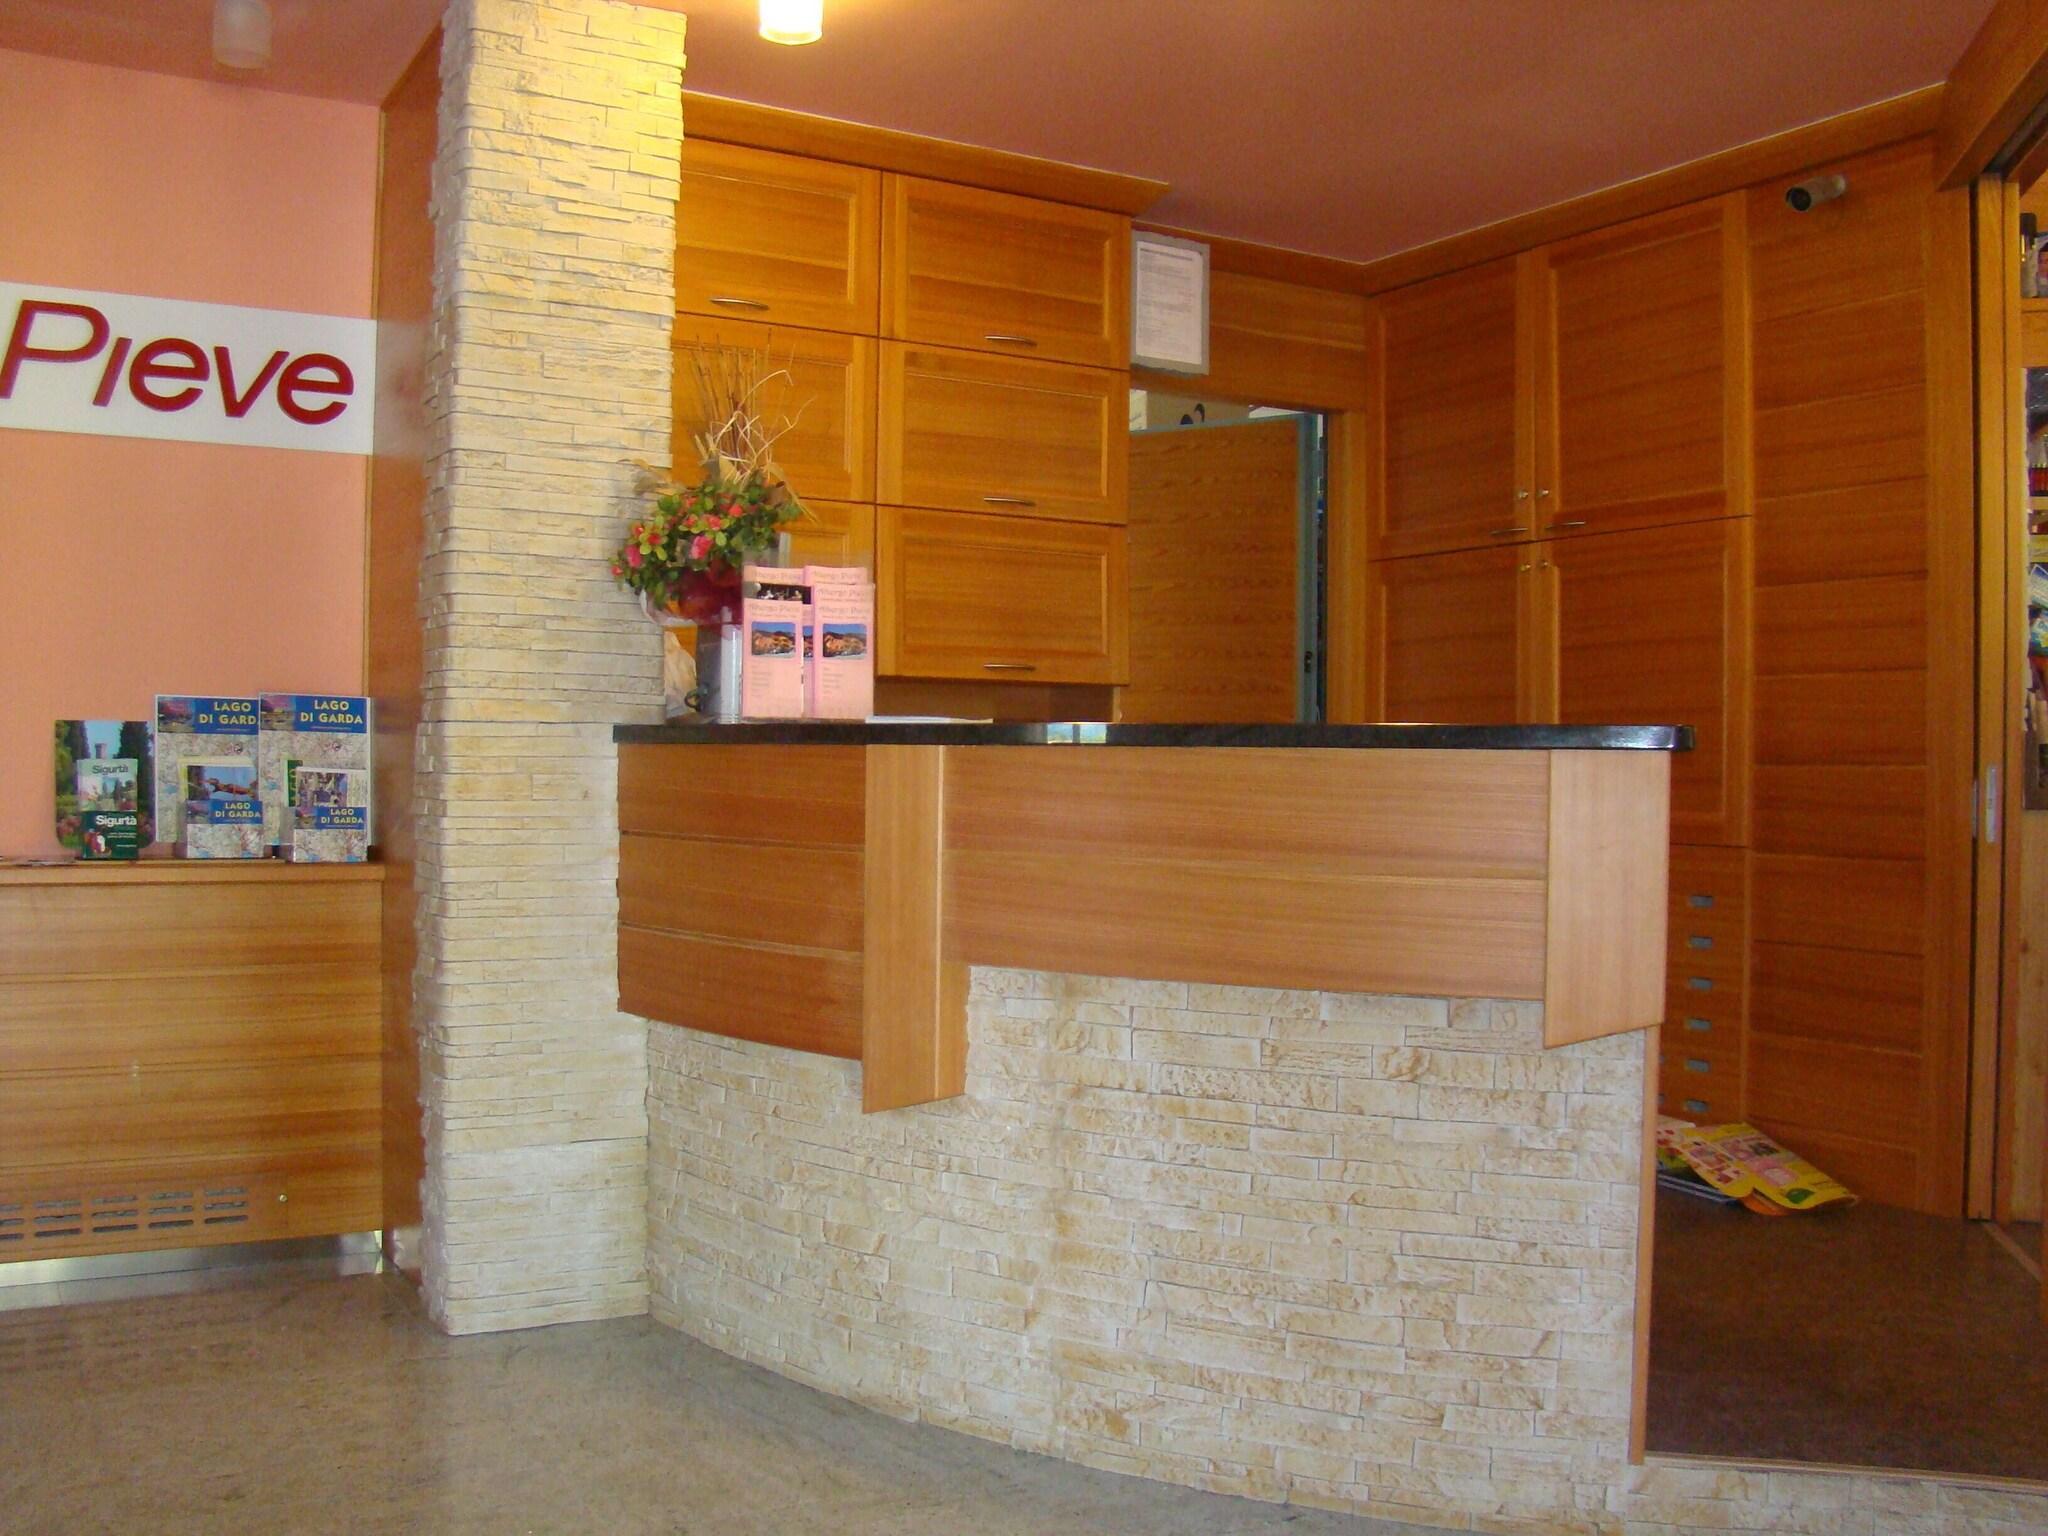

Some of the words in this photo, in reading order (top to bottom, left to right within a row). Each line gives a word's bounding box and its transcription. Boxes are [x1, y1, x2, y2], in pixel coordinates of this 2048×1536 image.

[214, 702, 251, 712] LAGO
[314, 700, 349, 711] LAGO
[200, 714, 213, 724] DI
[219, 714, 258, 725] GARD
[301, 712, 313, 722] DI
[319, 713, 363, 724] GARDA
[225, 802, 250, 810] LAGO
[215, 810, 225, 818] DI
[229, 810, 261, 818] GARDA
[330, 808, 354, 816] LAGO
[96, 815, 137, 827] Sigurtà
[321, 816, 330, 824] DI
[334, 816, 364, 824] GARDA
